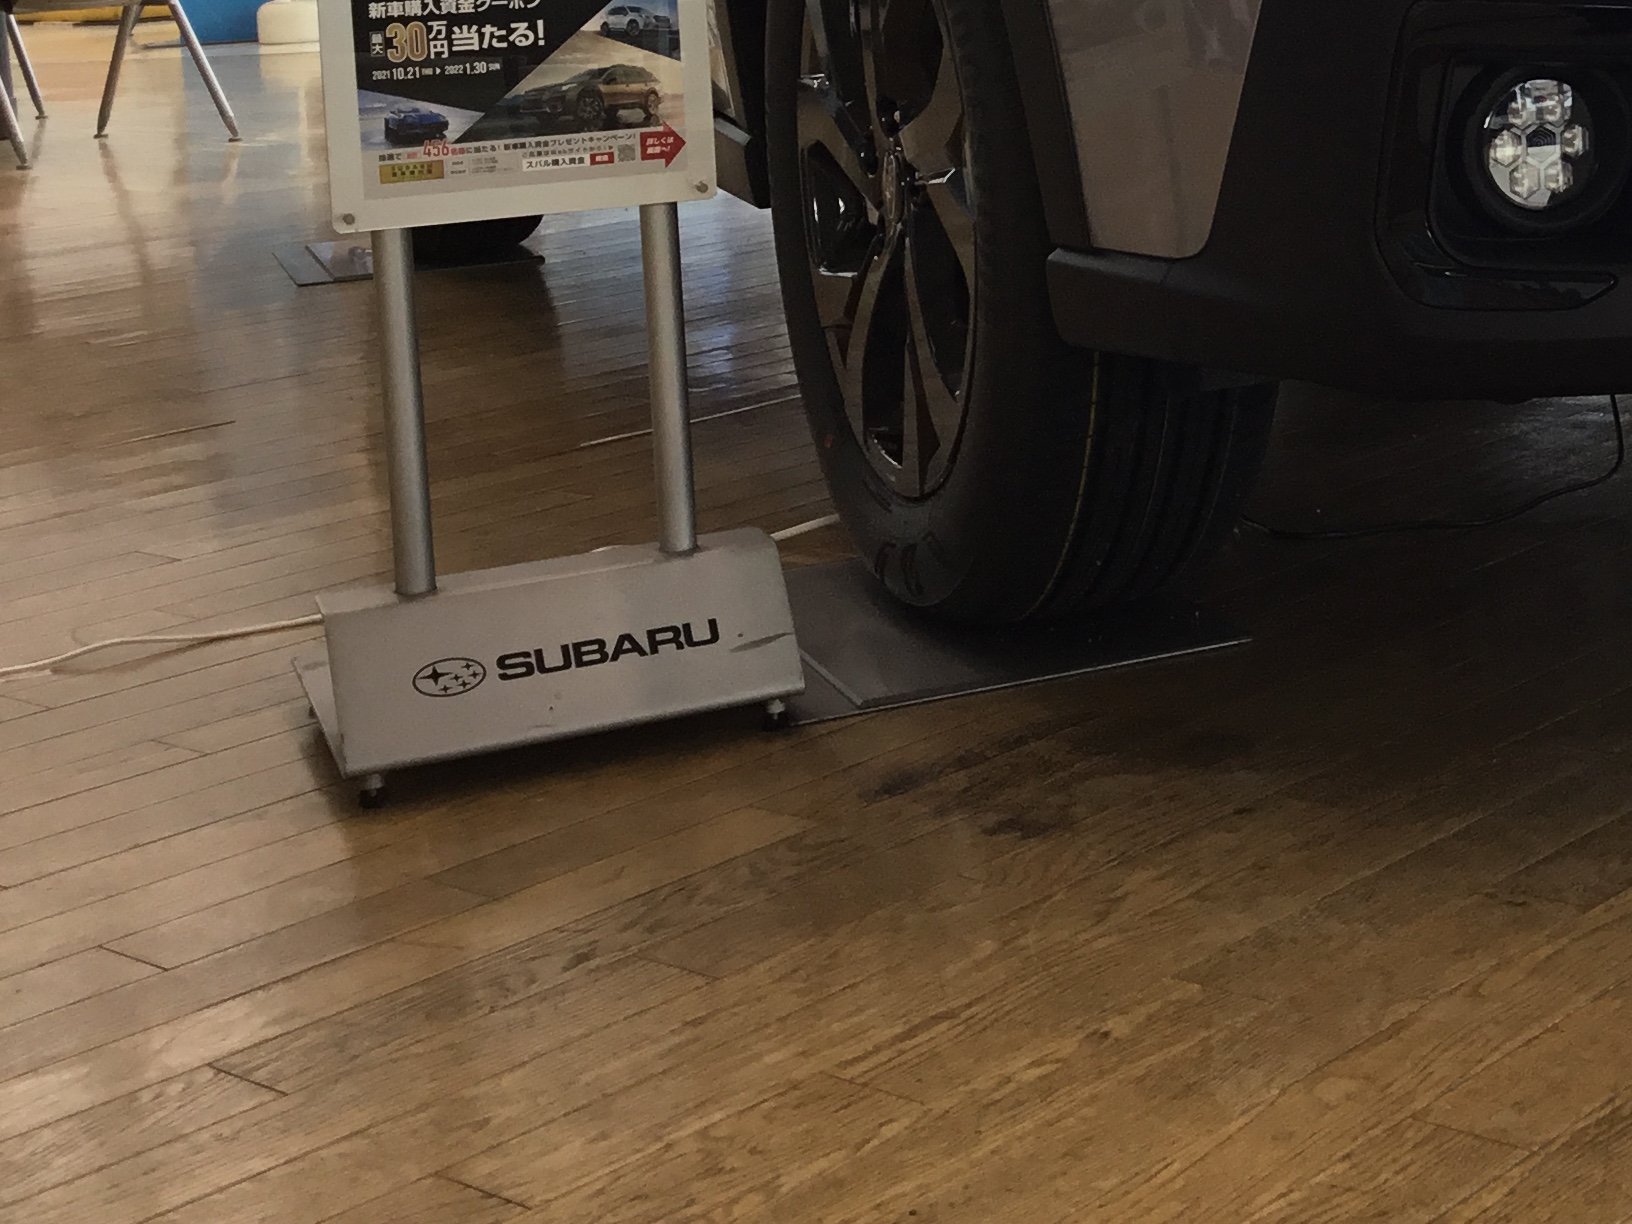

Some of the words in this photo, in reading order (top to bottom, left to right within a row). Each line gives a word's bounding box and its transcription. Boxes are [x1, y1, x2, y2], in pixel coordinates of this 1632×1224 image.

[451, 19, 545, 52] 当たる!
[372, 69, 391, 81] 2021
[392, 66, 420, 80] 10.21
[444, 65, 463, 76] 2022
[465, 61, 487, 75] 1.30
[423, 138, 449, 158] 456
[496, 618, 720, 681] SUBARU
